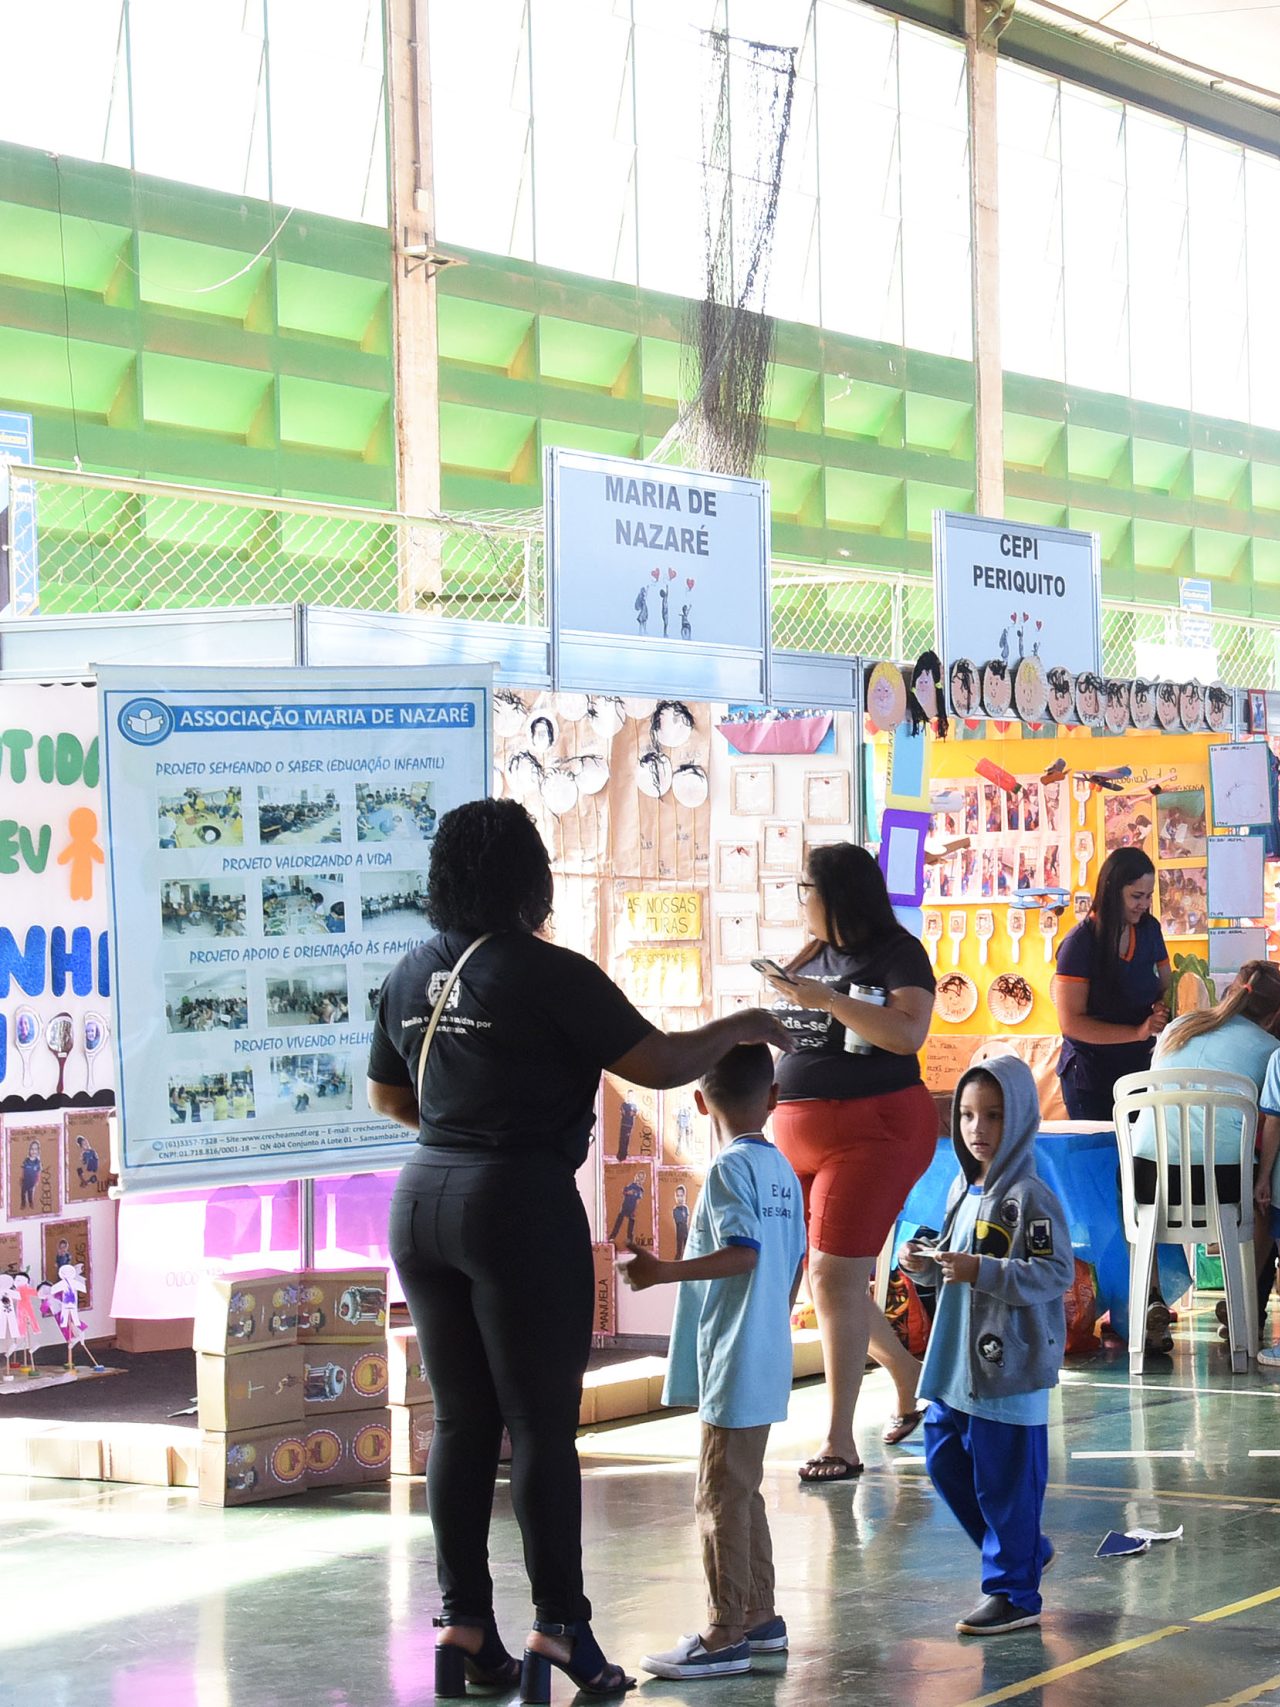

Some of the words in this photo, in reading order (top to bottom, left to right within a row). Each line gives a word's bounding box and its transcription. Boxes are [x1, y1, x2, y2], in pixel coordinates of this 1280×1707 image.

[605, 475, 682, 512] MARIA
[688, 488, 717, 517] DE
[615, 518, 710, 556] NAZARÉ
[1000, 533, 1039, 560] CEPI
[973, 564, 1066, 598] PERIQUITO
[180, 705, 299, 730] ASSOCIAÇÃO
[304, 706, 366, 726] MARIA
[371, 706, 395, 725] DE
[399, 702, 470, 724] NAZARÉ
[156, 760, 206, 777] PROJETO
[209, 759, 272, 775] SEMEANDO
[275, 759, 285, 773] O
[288, 758, 325, 773] SABER
[326, 757, 391, 773] (EDUCAÇÃO
[393, 755, 446, 772] INFANTIL)
[222, 857, 273, 872] PROJETO
[275, 854, 352, 870] VALORIZANDO
[355, 854, 364, 867] A
[366, 852, 393, 867] VIDA
[646, 896, 697, 913] NOSSAS
[189, 949, 240, 965] PROJETO
[243, 947, 279, 962] APOIO
[283, 946, 291, 960] E
[293, 941, 364, 959] ORIENTAÇÃO
[365, 939, 381, 956] ÀS
[476, 1020, 493, 1029] por
[234, 1036, 284, 1053] PROJETO
[286, 1034, 336, 1049] VIVENDO
[287, 1139, 320, 1150] Conjunto
[320, 1138, 327, 1146] A
[326, 1136, 343, 1147] Lote
[343, 1136, 353, 1144] 01
